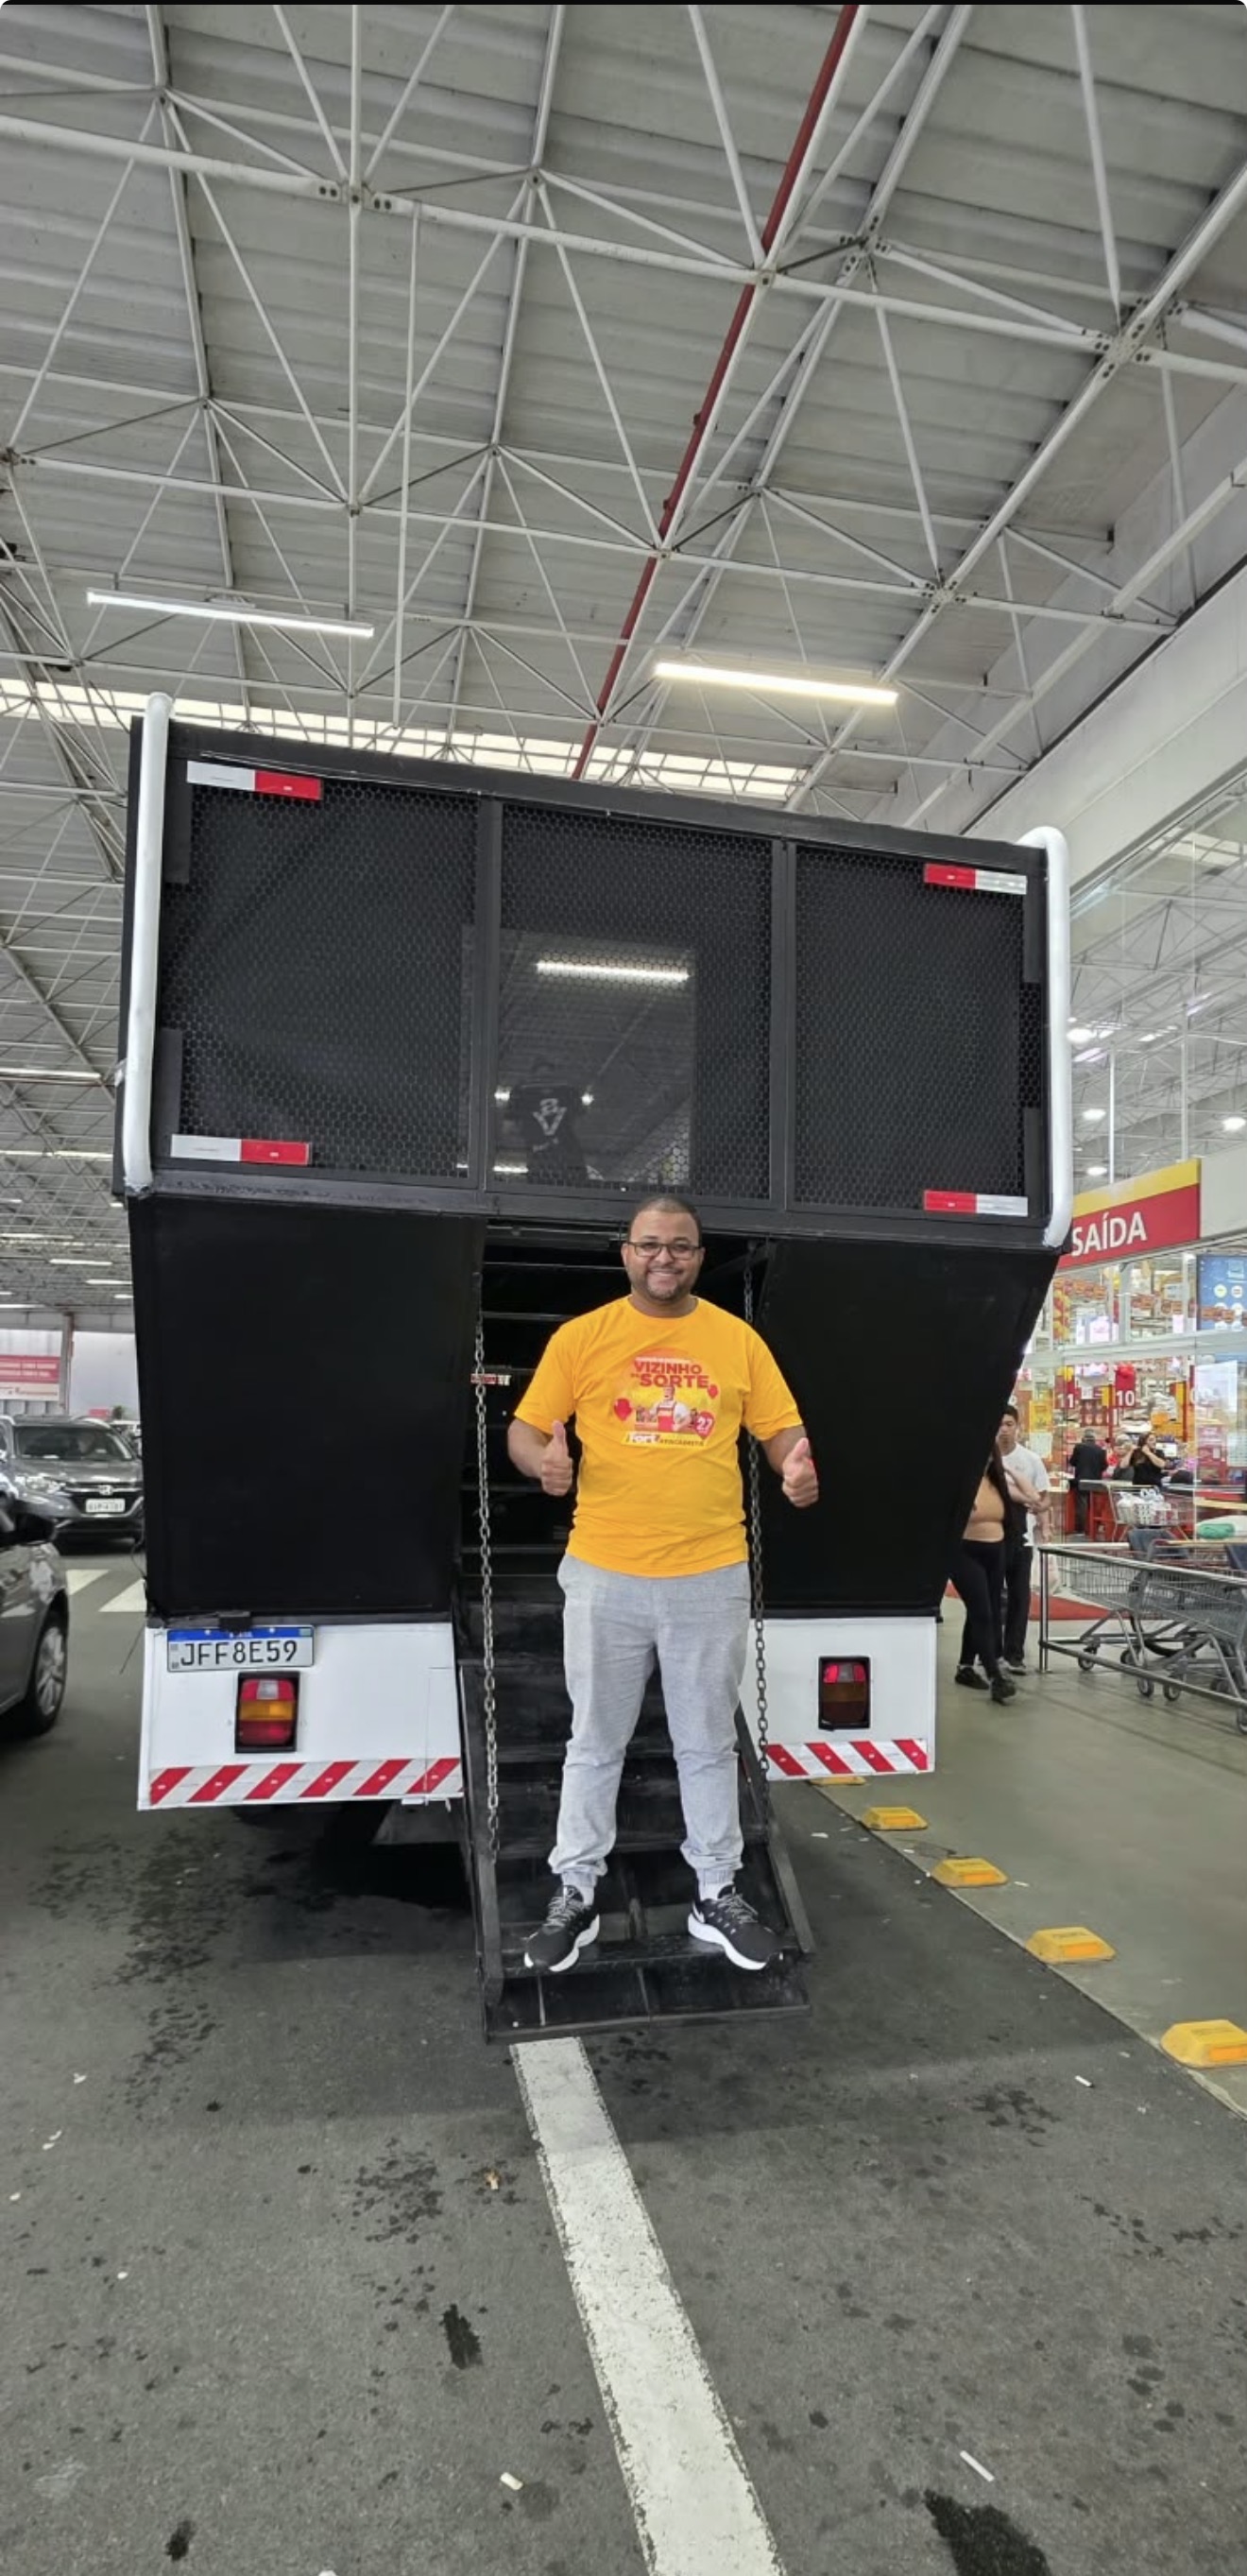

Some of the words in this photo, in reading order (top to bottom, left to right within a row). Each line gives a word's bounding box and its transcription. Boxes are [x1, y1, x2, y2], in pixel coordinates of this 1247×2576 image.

[1070, 1211, 1148, 1257] SAÍDA
[634, 1361, 702, 1375] VIZINHO
[640, 1373, 709, 1388] SORTE
[1057, 1393, 1075, 1409] 11
[1116, 1391, 1135, 1406] 10
[696, 1417, 713, 1432] 27
[180, 1640, 298, 1666] JFF8E59
